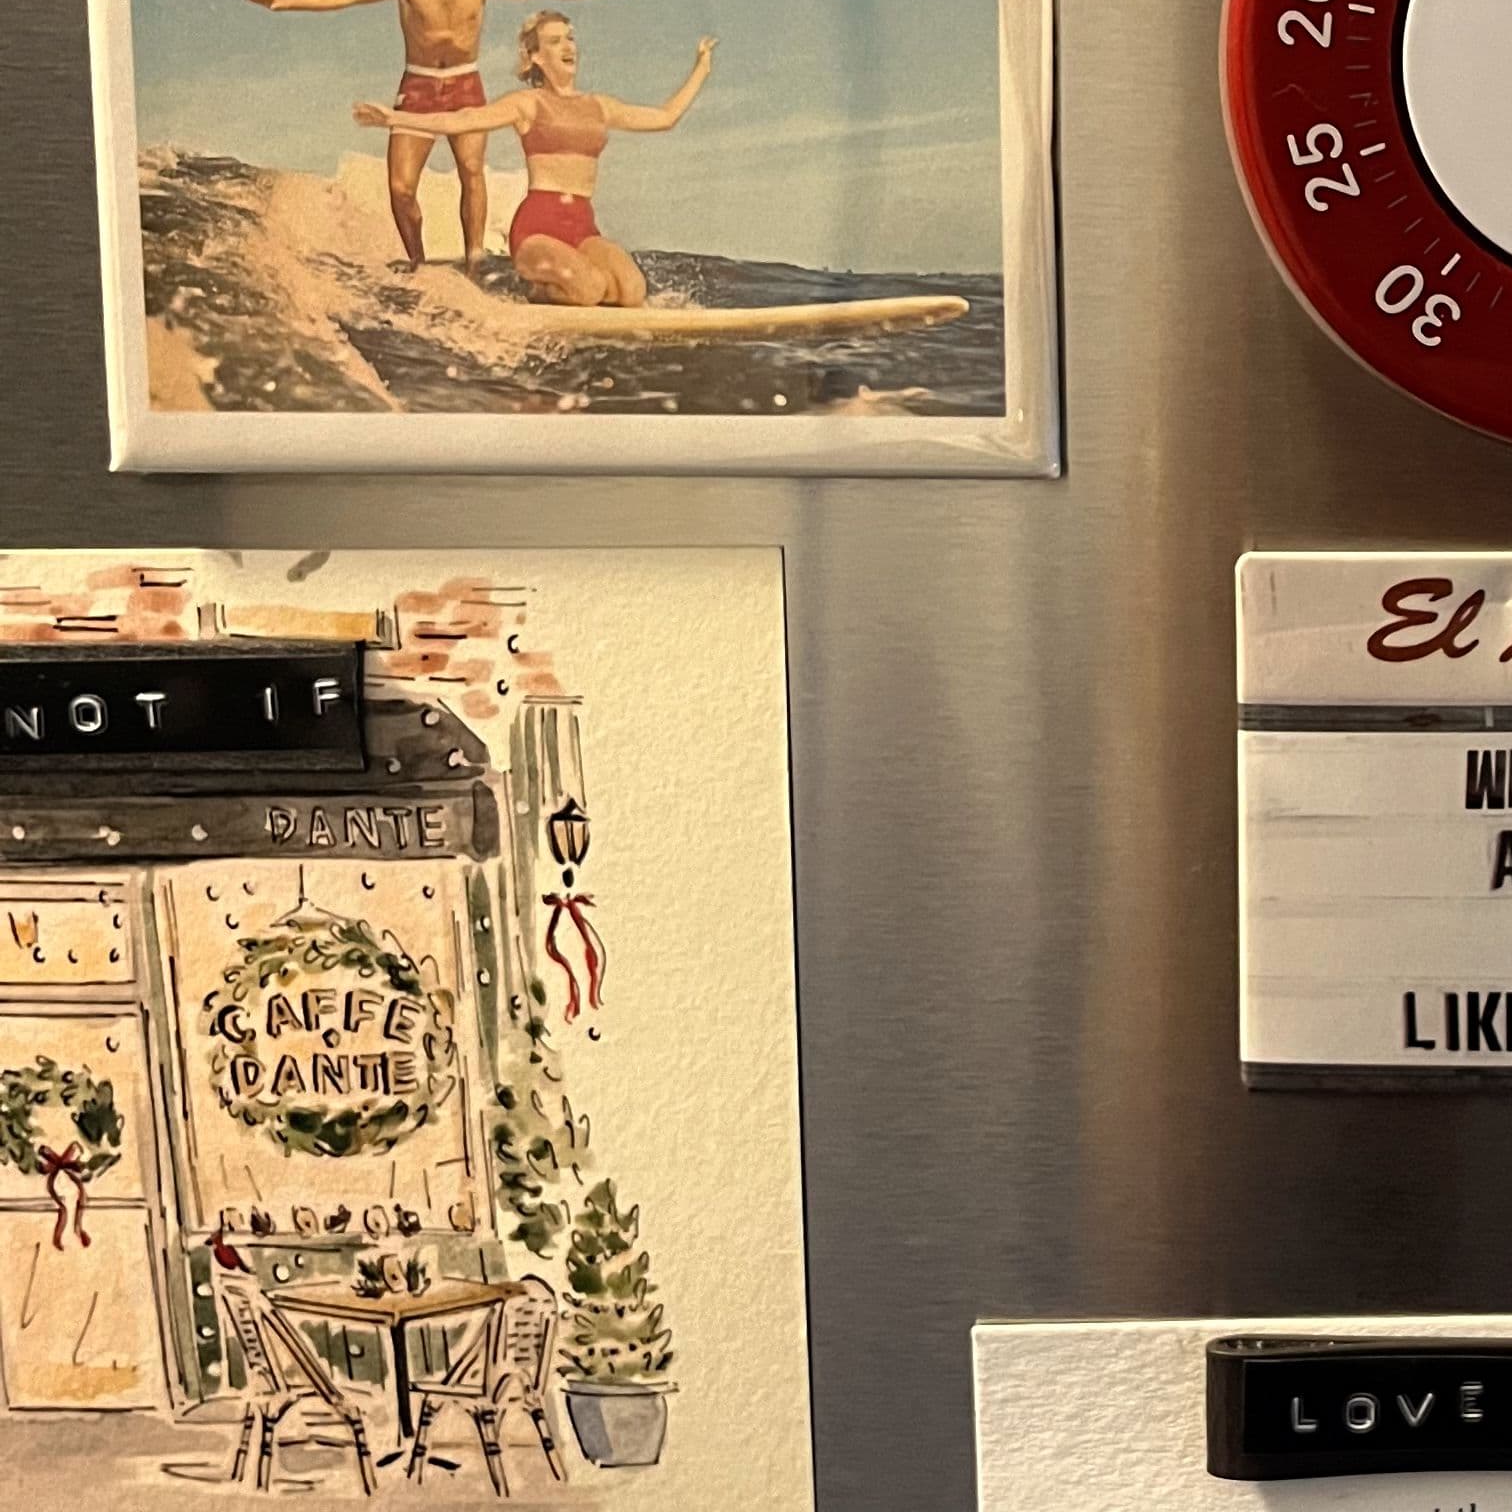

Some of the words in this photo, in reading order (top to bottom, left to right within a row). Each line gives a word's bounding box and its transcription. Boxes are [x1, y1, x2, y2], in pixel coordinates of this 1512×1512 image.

[1287, 123, 1361, 212] 25
[1375, 264, 1461, 347] 30
[1366, 577, 1485, 663] El
[4, 691, 168, 741] NOT
[262, 678, 343, 725] IF
[265, 805, 449, 849] DANTE
[217, 987, 428, 1045] CAFFE
[230, 1051, 421, 1100] DANTE
[1290, 1382, 1484, 1434] LOVE
